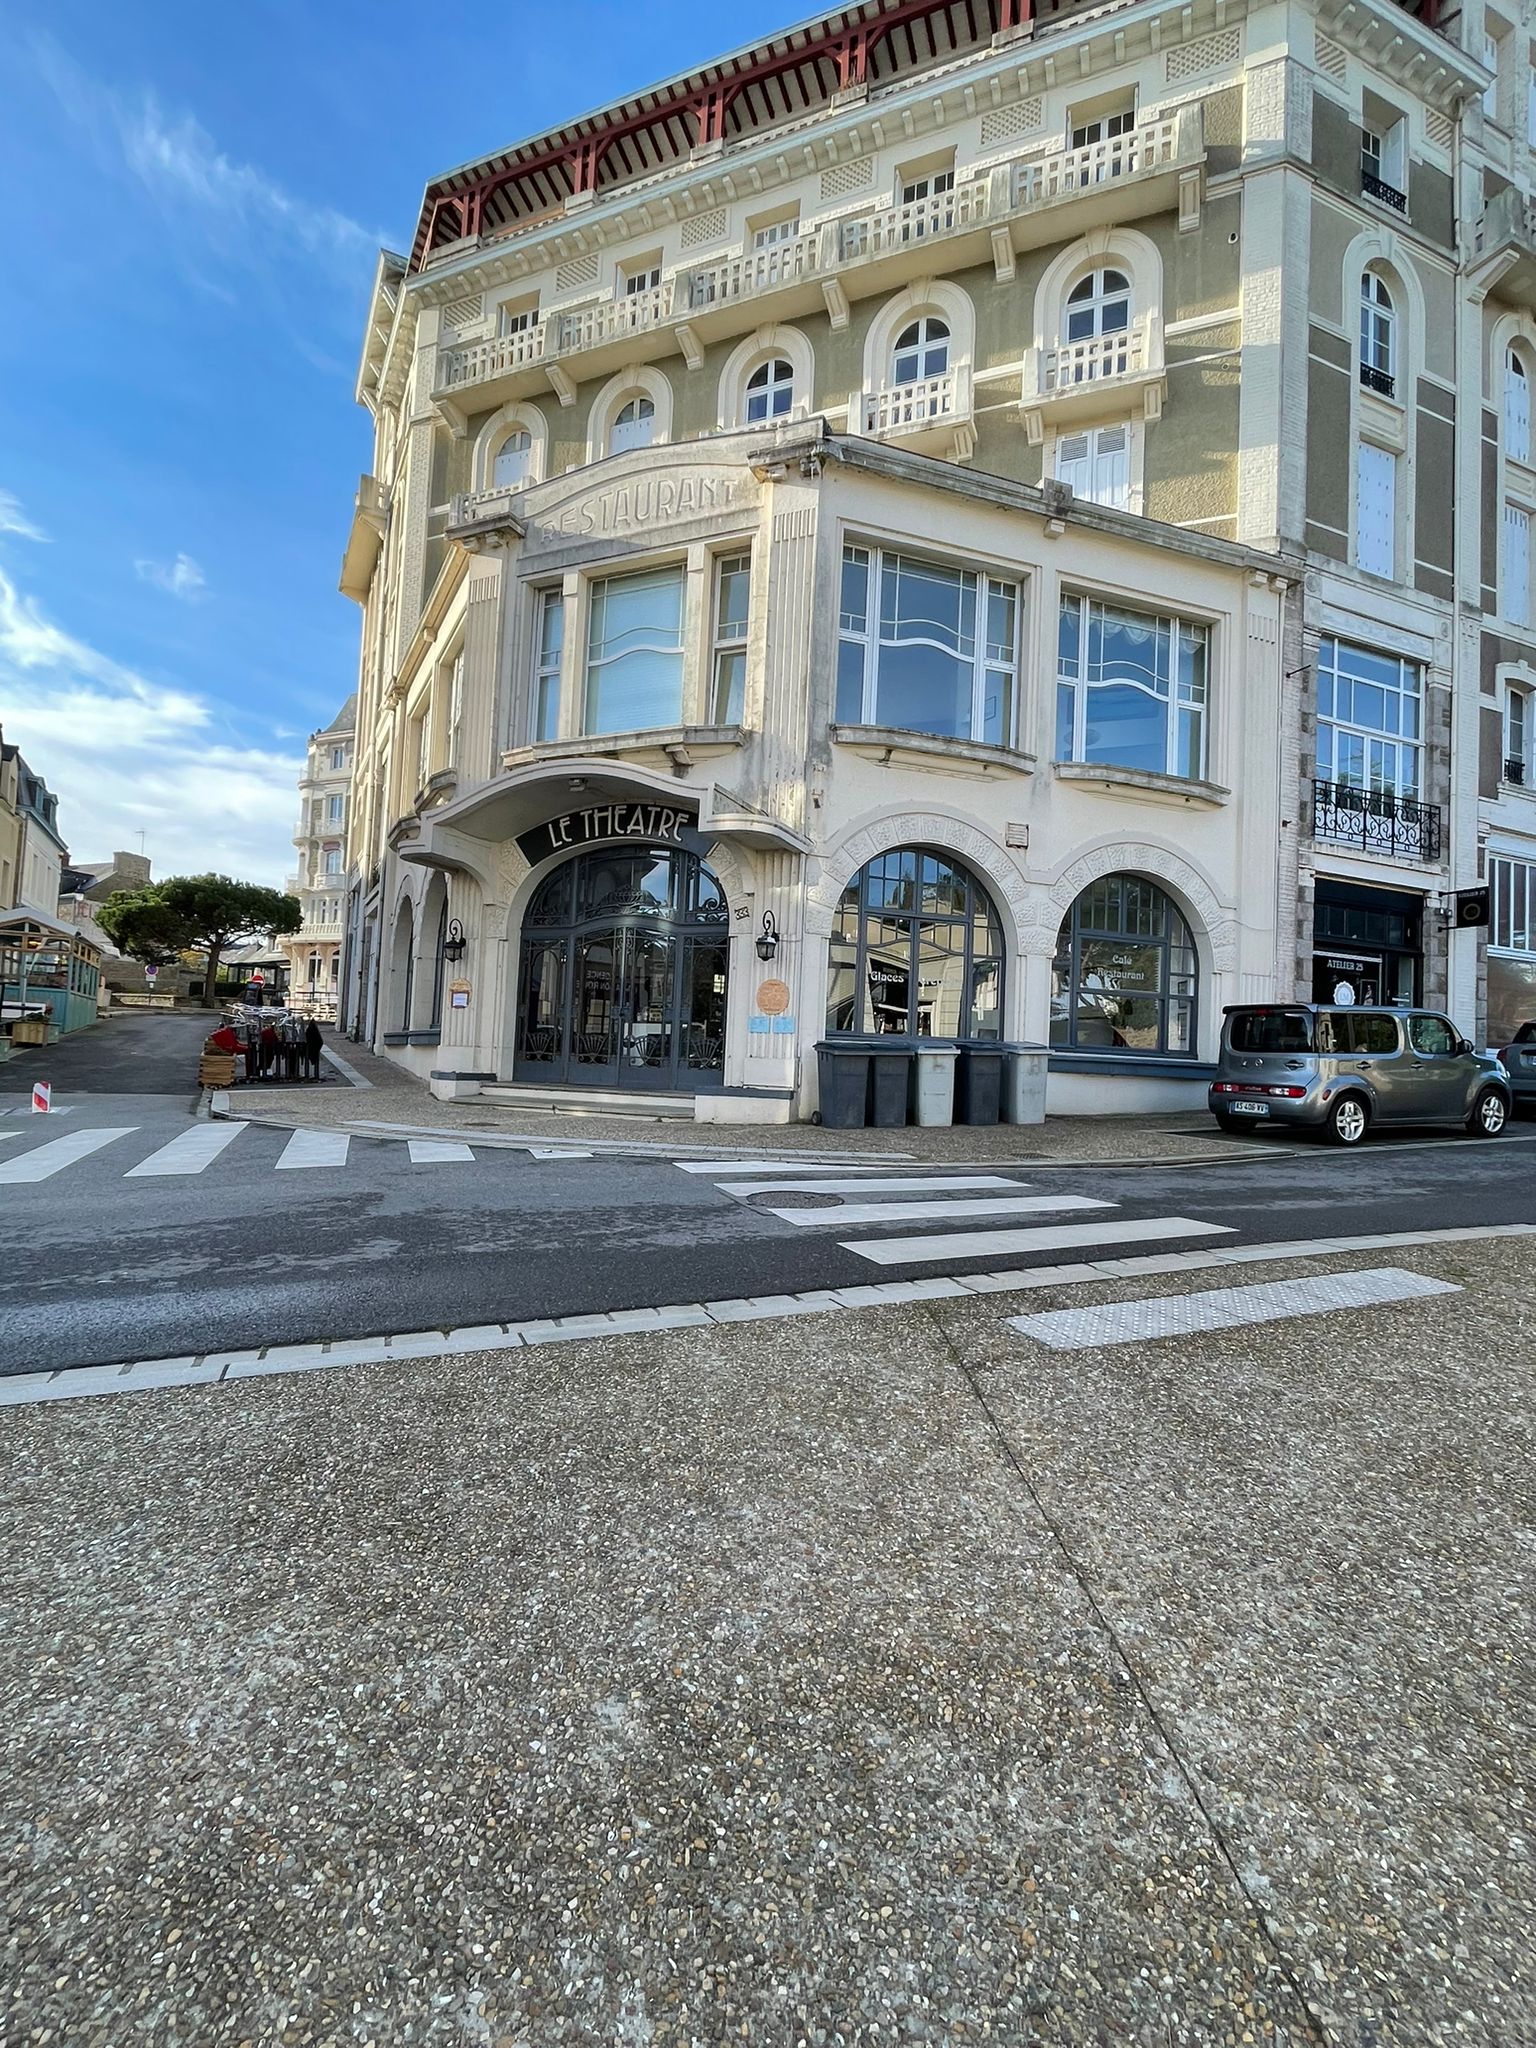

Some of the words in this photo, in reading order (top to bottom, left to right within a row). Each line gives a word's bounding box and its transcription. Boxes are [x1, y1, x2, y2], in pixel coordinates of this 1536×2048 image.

[540, 477, 738, 545] RESTAURANT
[548, 816, 573, 848] LE
[579, 804, 690, 842] THEATRE
[870, 970, 905, 983] Glaces
[1327, 959, 1355, 970] ATELIER
[1355, 963, 1364, 971] 25
